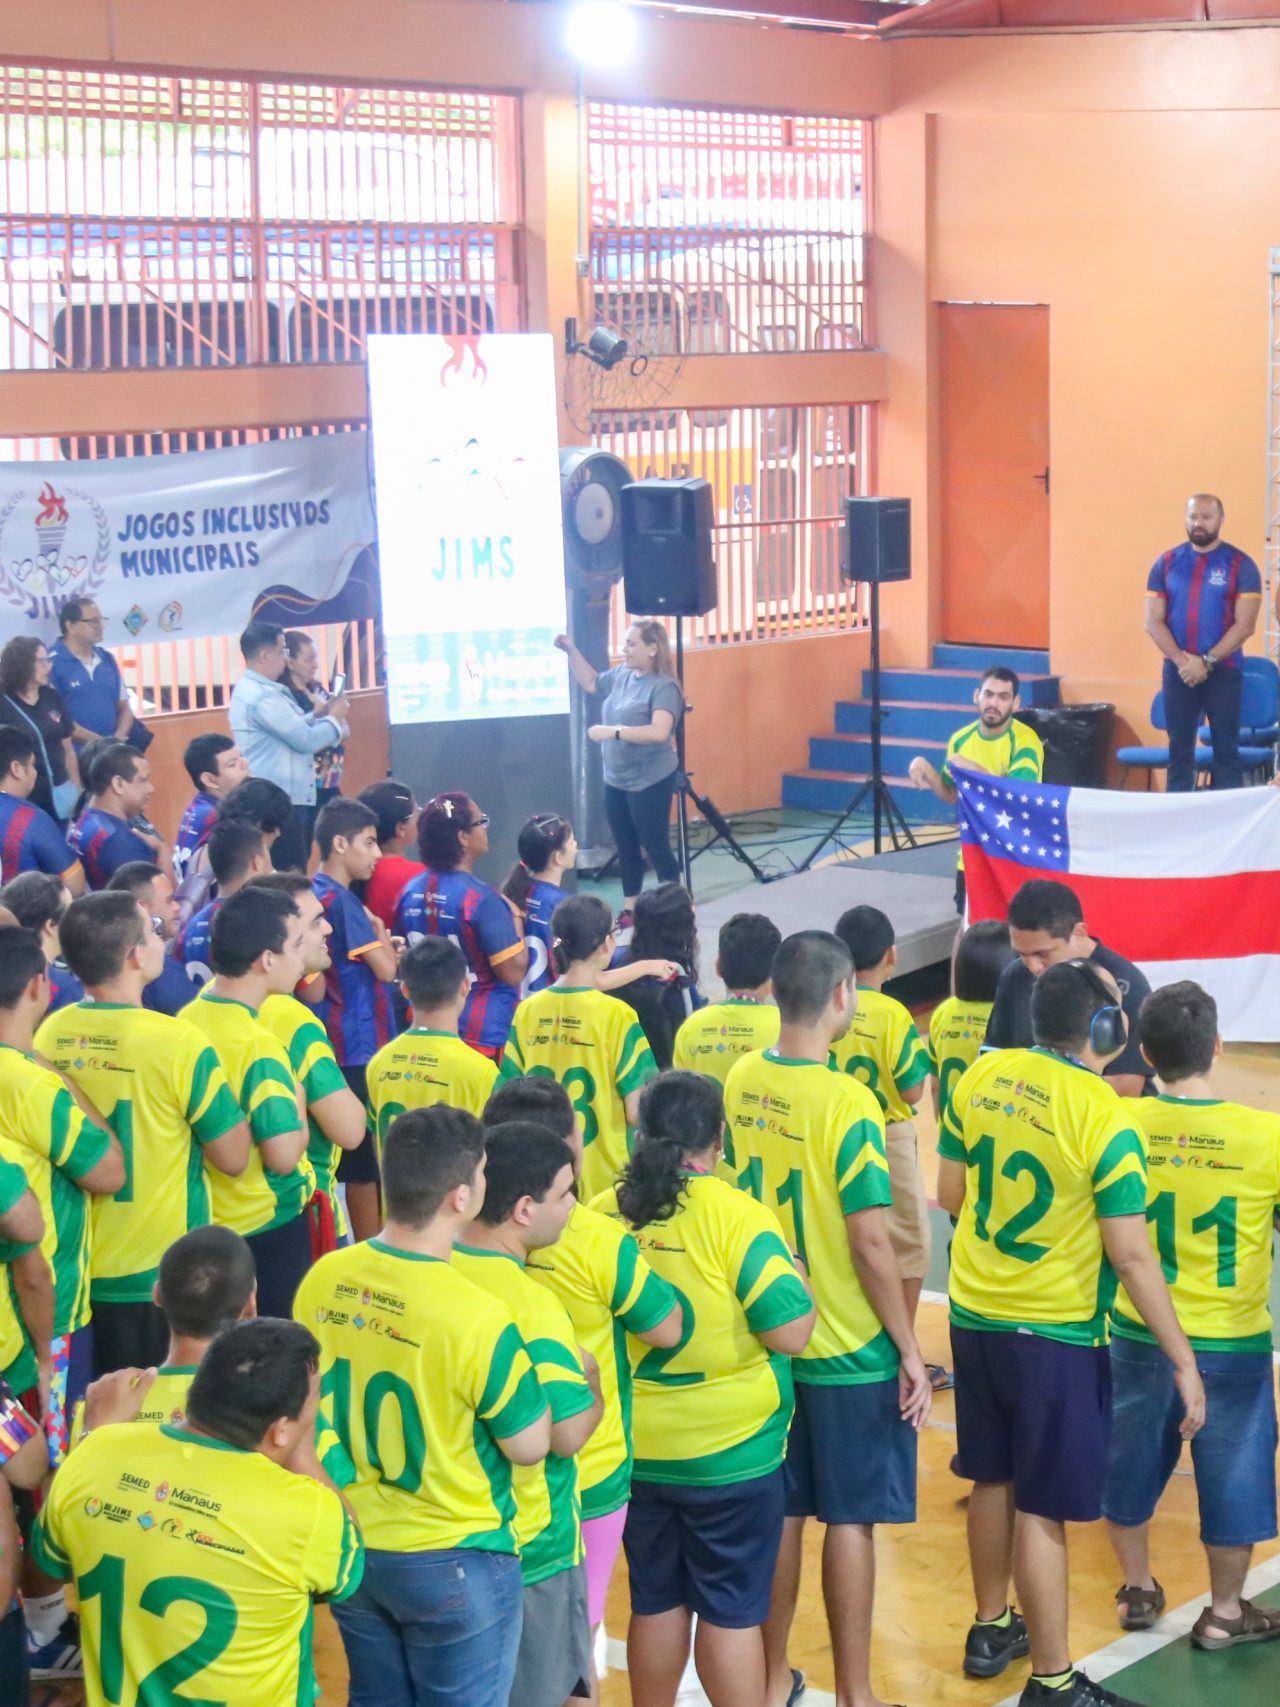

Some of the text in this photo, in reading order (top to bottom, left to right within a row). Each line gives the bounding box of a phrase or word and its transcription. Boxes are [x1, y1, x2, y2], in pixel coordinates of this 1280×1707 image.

[118, 499, 330, 542] JOGOS INCLUSIVOS
[120, 541, 260, 578] MUNICIPAIS
[431, 535, 515, 581] JIMS
[25, 594, 80, 619] JIM
[1189, 1135, 1225, 1146] Manaus
[737, 1155, 811, 1278] 11
[966, 1134, 1055, 1264] 12
[1146, 1191, 1238, 1289] 11
[372, 1291, 406, 1310] Manaus
[136, 1411, 164, 1420] EMED
[320, 1356, 427, 1494] 10
[120, 1472, 151, 1489] SEMED
[171, 1487, 222, 1512] Manaus
[77, 1553, 238, 1707] 12
